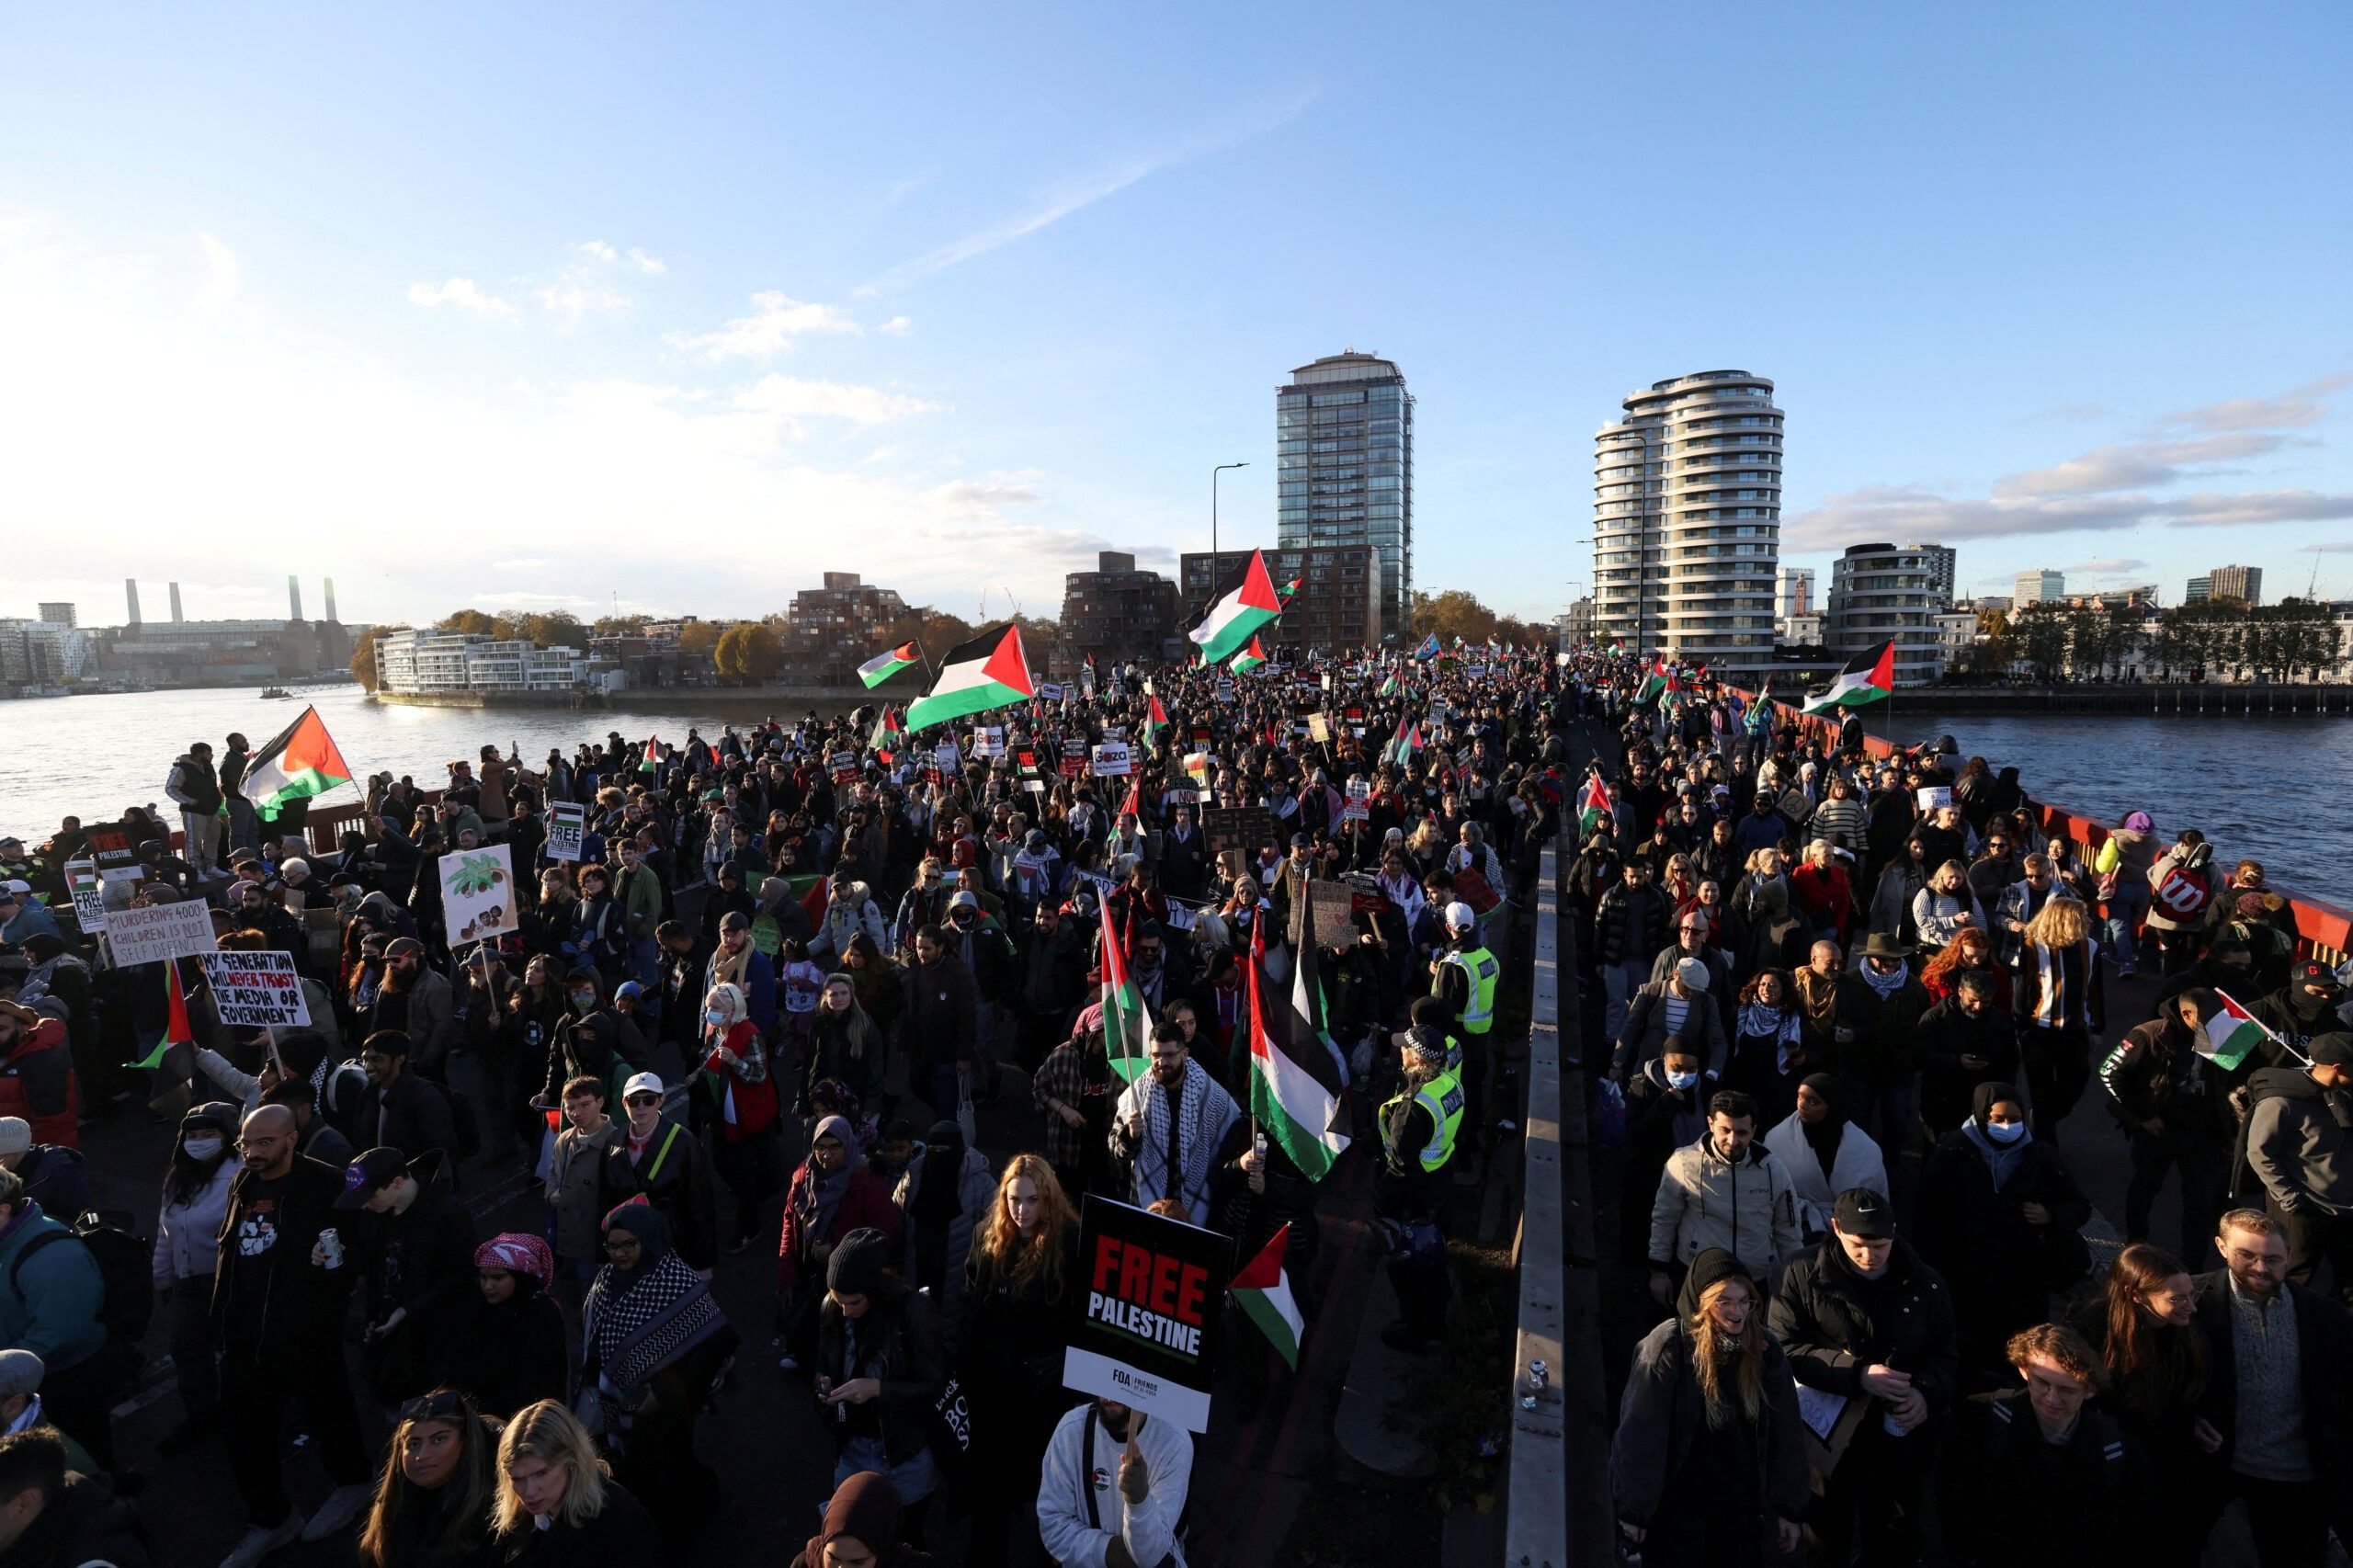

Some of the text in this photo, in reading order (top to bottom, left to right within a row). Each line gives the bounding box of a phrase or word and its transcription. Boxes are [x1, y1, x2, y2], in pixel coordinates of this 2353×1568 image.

[551, 824, 581, 842] FREE
[549, 838, 579, 849] PALESTINE
[98, 849, 132, 860] PALESTINE
[74, 891, 102, 910] FREE
[1352, 887, 1378, 896] ALESTINE
[108, 908, 174, 931] MURDERING
[170, 926, 181, 938] IS
[184, 920, 207, 937] NOT
[119, 937, 199, 963] SELF DEFENCE
[201, 952, 294, 971] MY GENERATION
[2308, 965, 2320, 975] G
[207, 971, 297, 990] WILL NEVER TRUST
[212, 987, 300, 1006] THE MEDIA OR
[220, 1005, 298, 1025] GOVERNMENT
[1092, 1234, 1208, 1326] FREE
[1087, 1291, 1201, 1357] PALESTINE
[1113, 1369, 1131, 1386] FOA
[1133, 1378, 1158, 1392] FRIENDS
